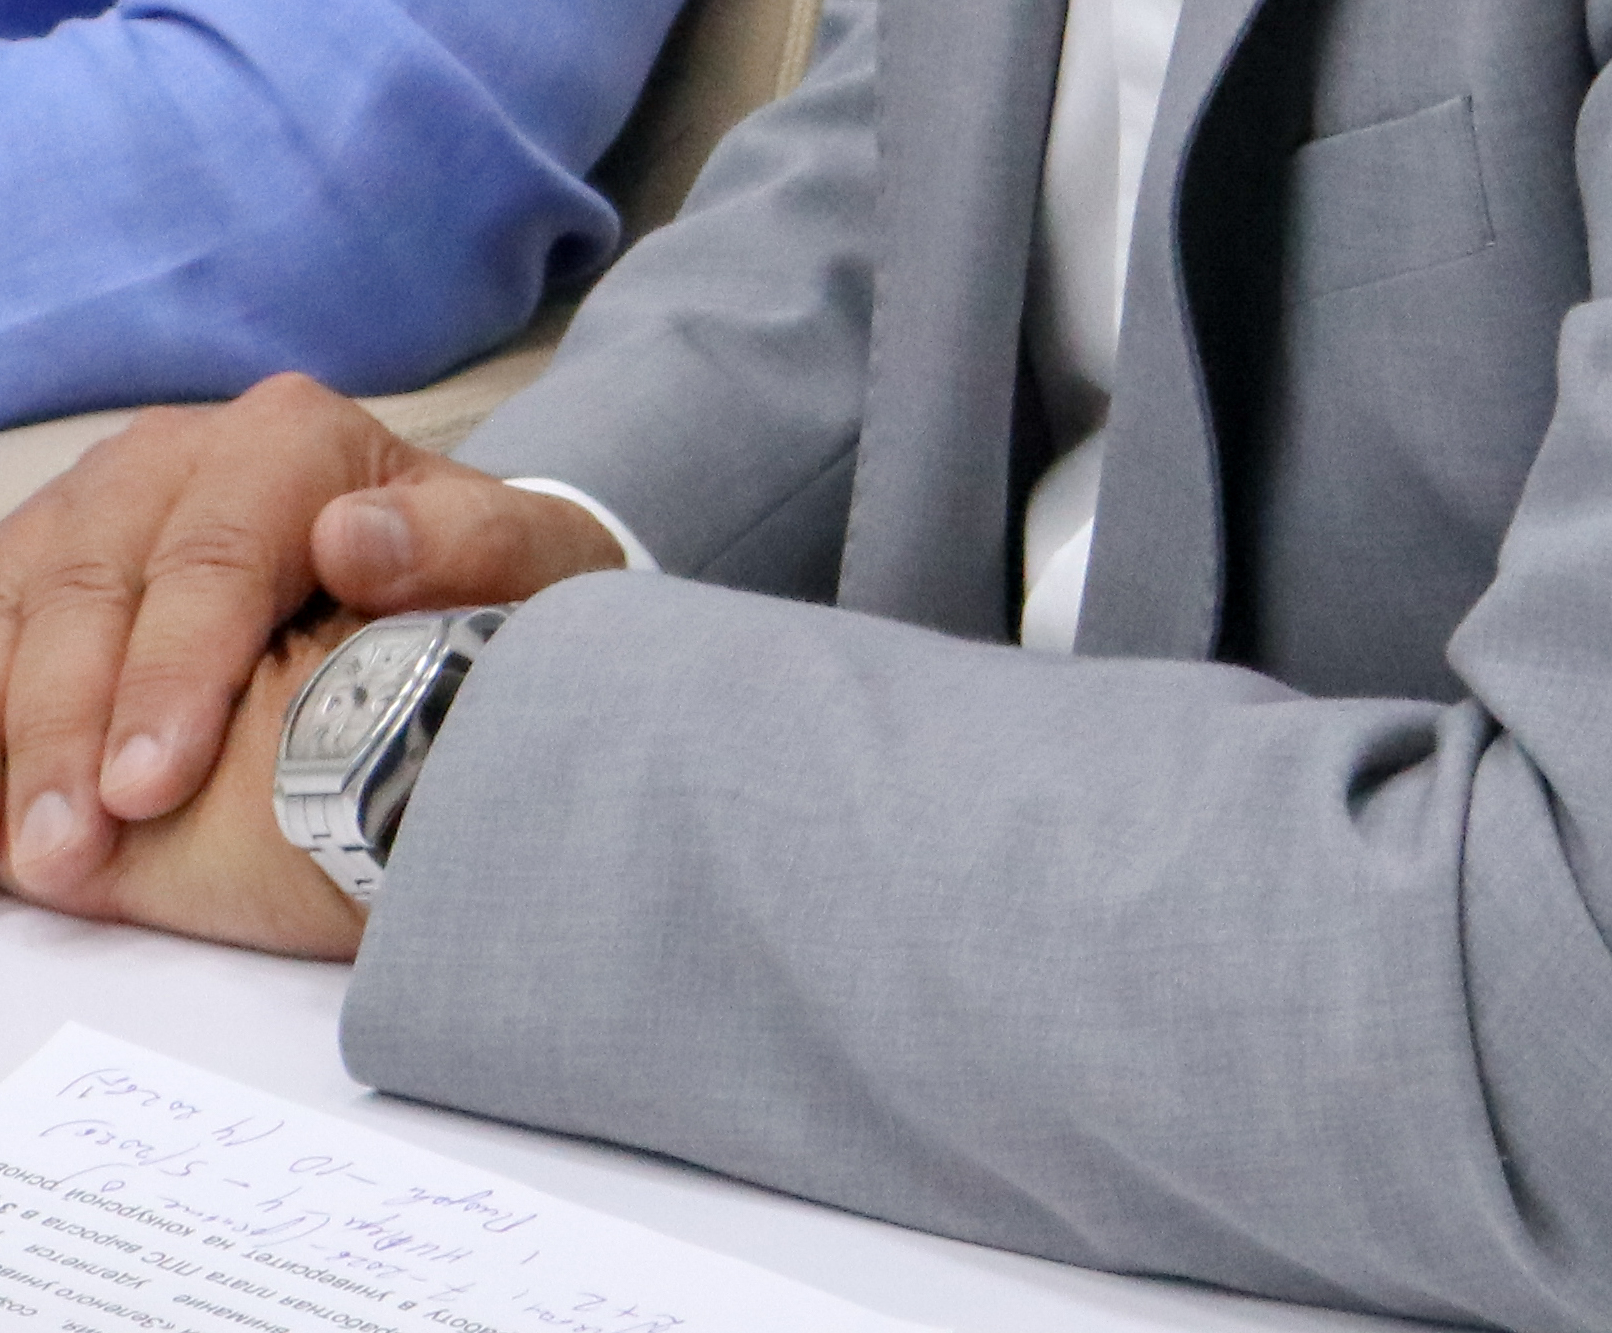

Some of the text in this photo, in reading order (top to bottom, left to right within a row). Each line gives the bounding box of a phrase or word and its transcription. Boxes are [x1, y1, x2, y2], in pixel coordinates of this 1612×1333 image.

[63, 1188, 195, 1237] конкурсной
[41, 1217, 143, 1253] выросла
[203, 1235, 235, 1250] на
[24, 1245, 151, 1289] уделяется
[141, 1252, 202, 1276] ППС
[242, 1250, 394, 1302] университет
[205, 1271, 277, 1299] плата
[55, 1288, 175, 1330] «Зеленого
